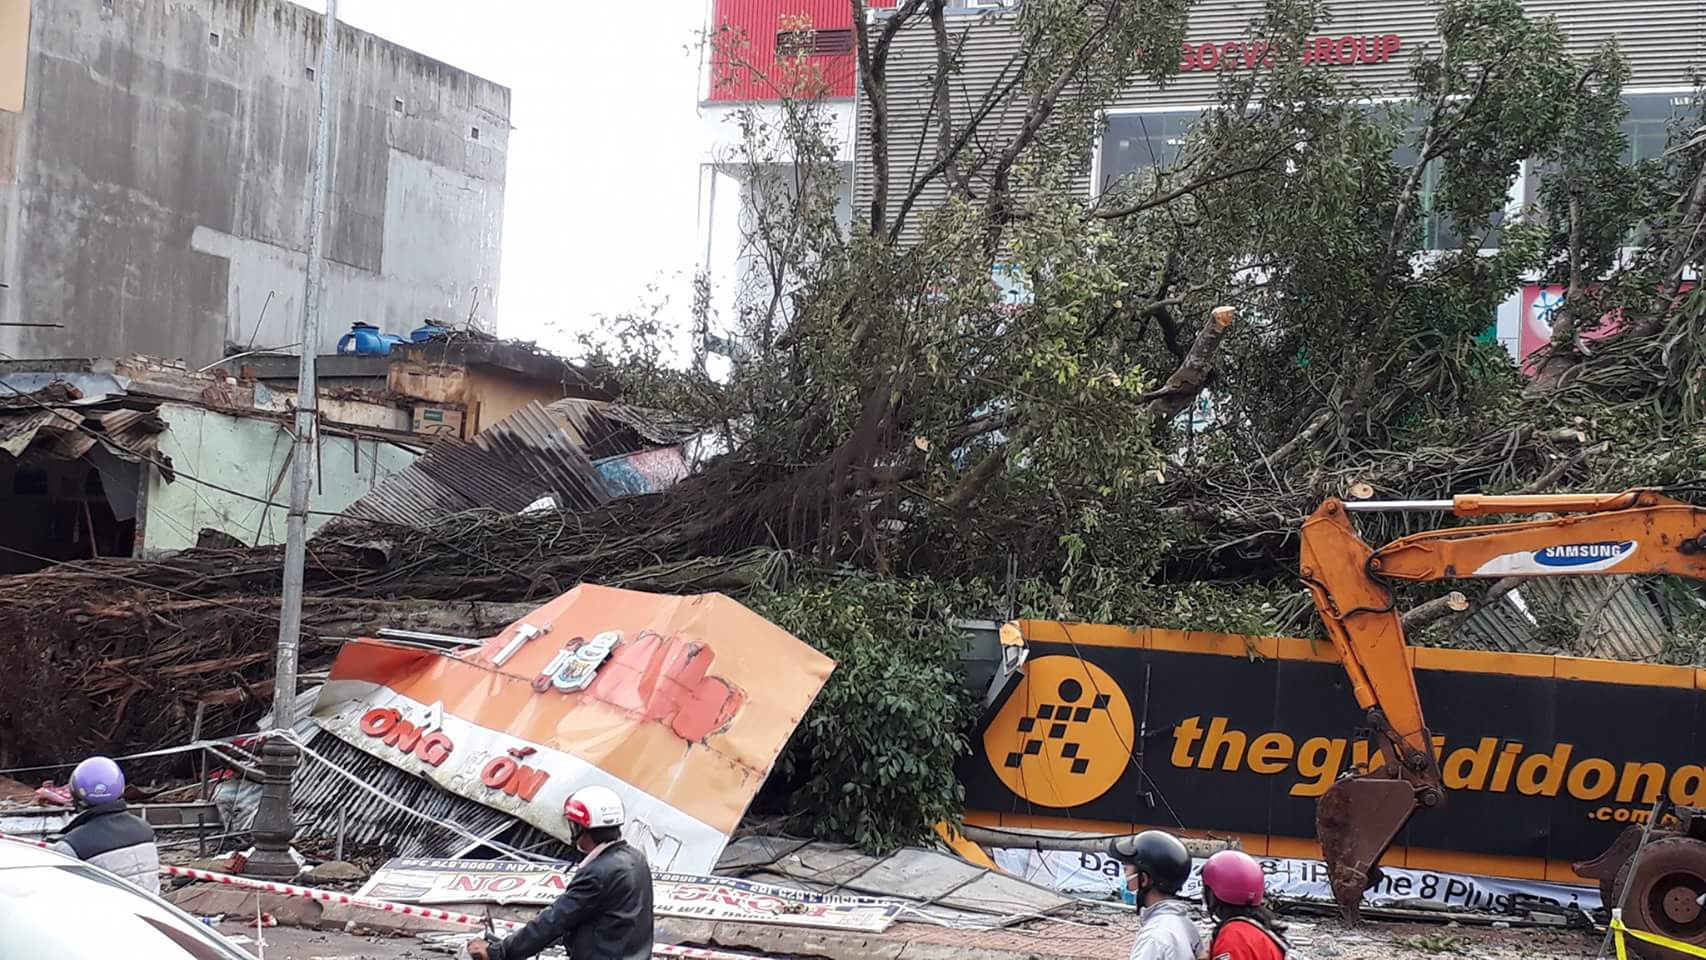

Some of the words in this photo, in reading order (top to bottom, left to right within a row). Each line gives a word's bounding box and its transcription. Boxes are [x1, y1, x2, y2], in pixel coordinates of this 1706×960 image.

[1545, 545, 1621, 558] SAMSUNG
[1301, 859, 1412, 896] iPne
[1420, 874, 1439, 899] 8
